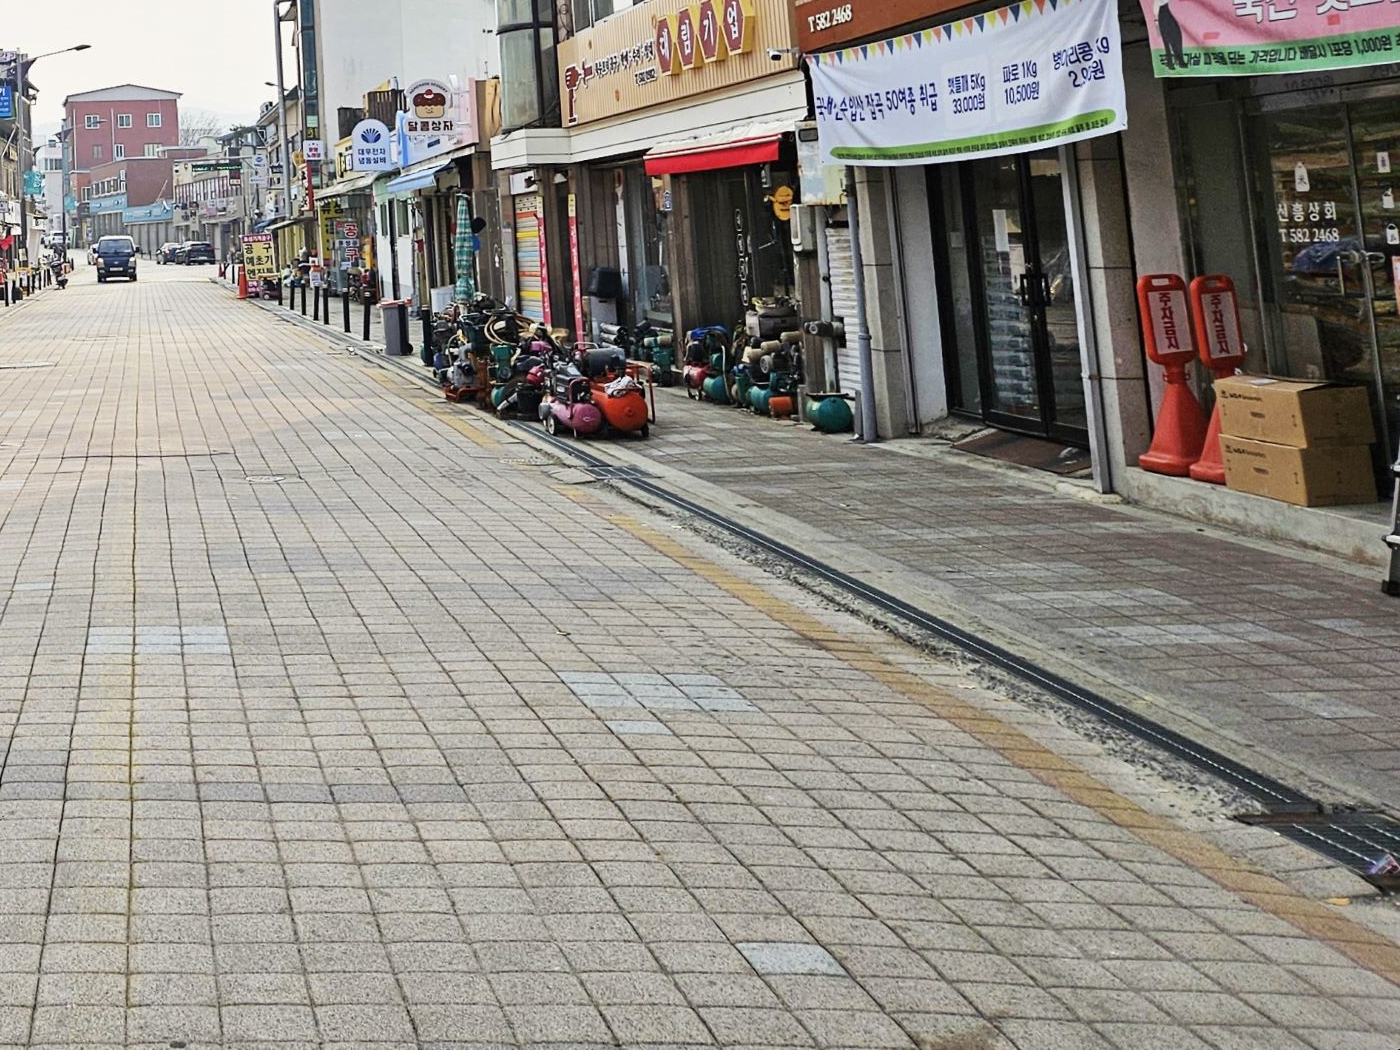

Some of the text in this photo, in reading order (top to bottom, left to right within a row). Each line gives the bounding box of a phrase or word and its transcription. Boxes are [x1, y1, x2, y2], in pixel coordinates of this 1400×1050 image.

[807, 3, 853, 33] T 582 2468
[658, 0, 739, 62] 대림기업
[1249, 47, 1297, 64] 가격입니다
[1354, 34, 1393, 55] 1,000원
[970, 73, 986, 92] 5Kg
[1002, 60, 1038, 84] 파로 1Kg
[865, 92, 885, 120] 잡곡
[885, 86, 916, 115] 50여종
[919, 82, 938, 112] 취급
[952, 93, 986, 114] 33,000원
[1004, 81, 1040, 106] 10,500원
[407, 120, 454, 132] 달콤상자
[357, 147, 386, 156] 대우전자
[1277, 200, 1337, 222] 신흥상회
[1278, 227, 1340, 243] T 582 2468
[1158, 292, 1180, 351] 주차금지
[1210, 294, 1231, 355] 주차금지
